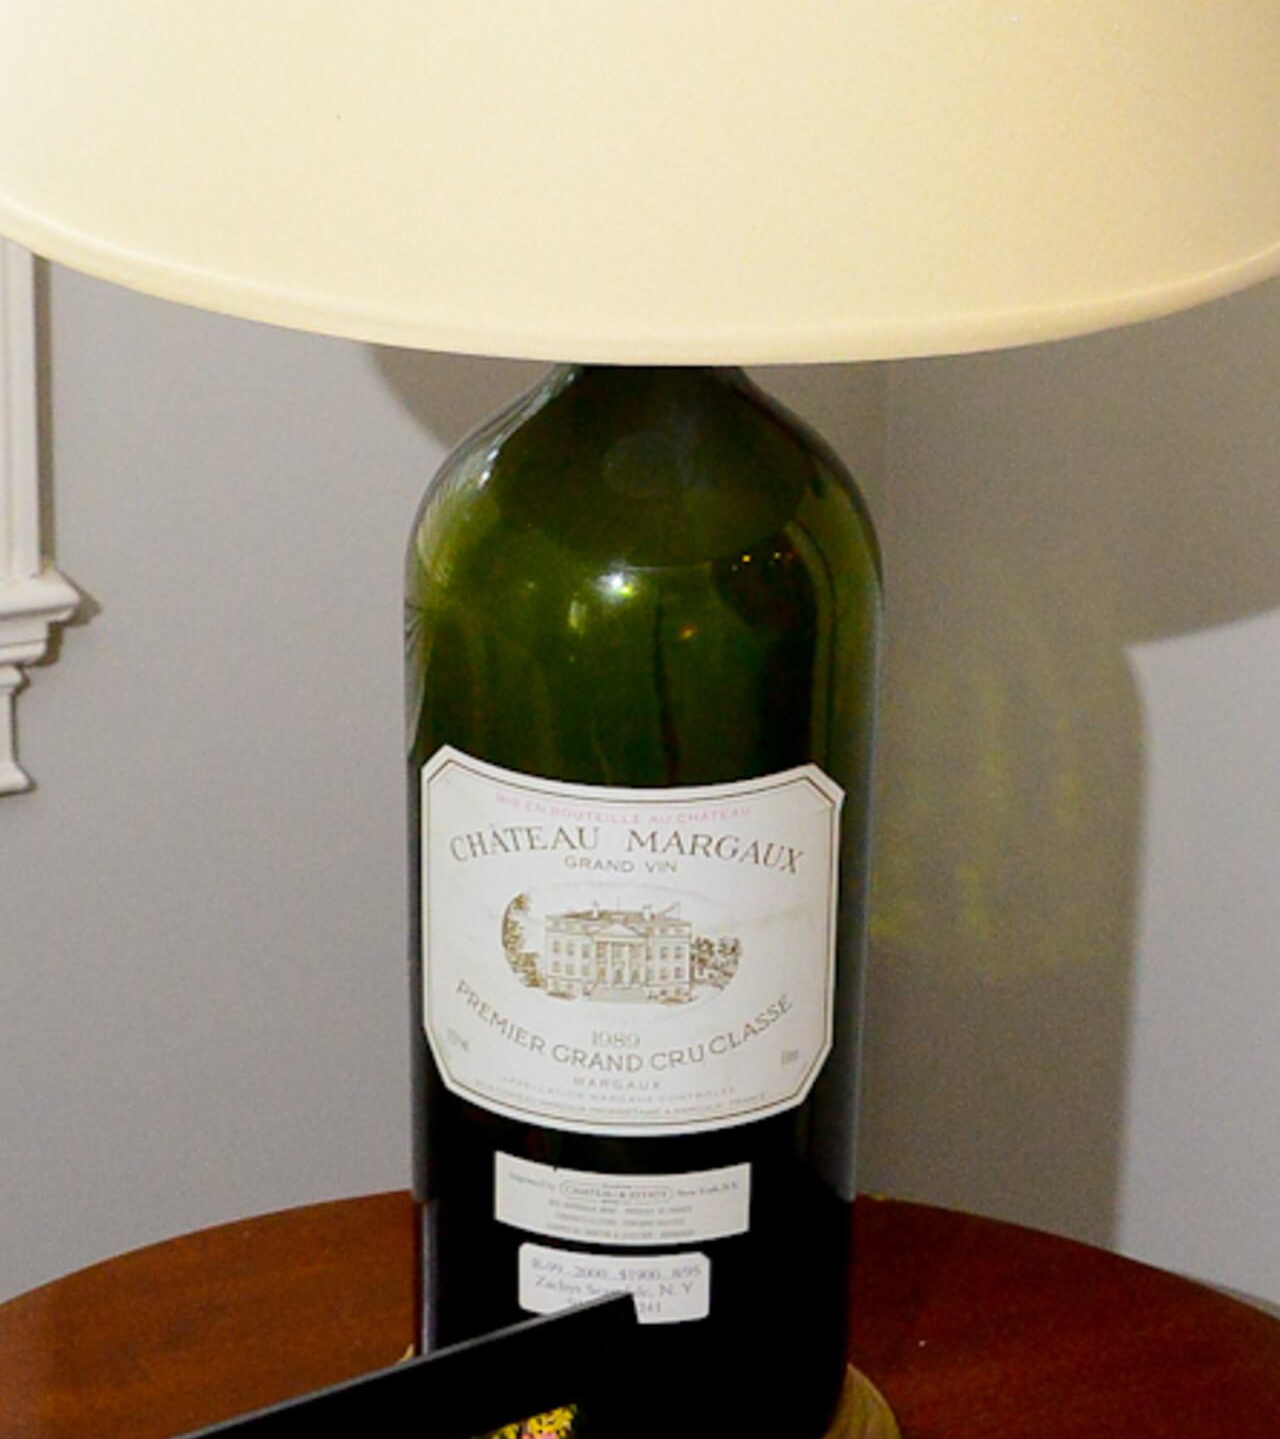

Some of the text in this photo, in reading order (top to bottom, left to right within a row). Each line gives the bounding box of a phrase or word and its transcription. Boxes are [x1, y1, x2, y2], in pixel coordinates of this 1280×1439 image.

[564, 855, 679, 874] GRAND VIN
[625, 827, 805, 875] MARGAUX
[455, 979, 546, 1054] PREMIER
[550, 1043, 644, 1074] GRAND
[649, 1044, 705, 1071] CRU
[573, 1075, 662, 1091] MARGAUX
